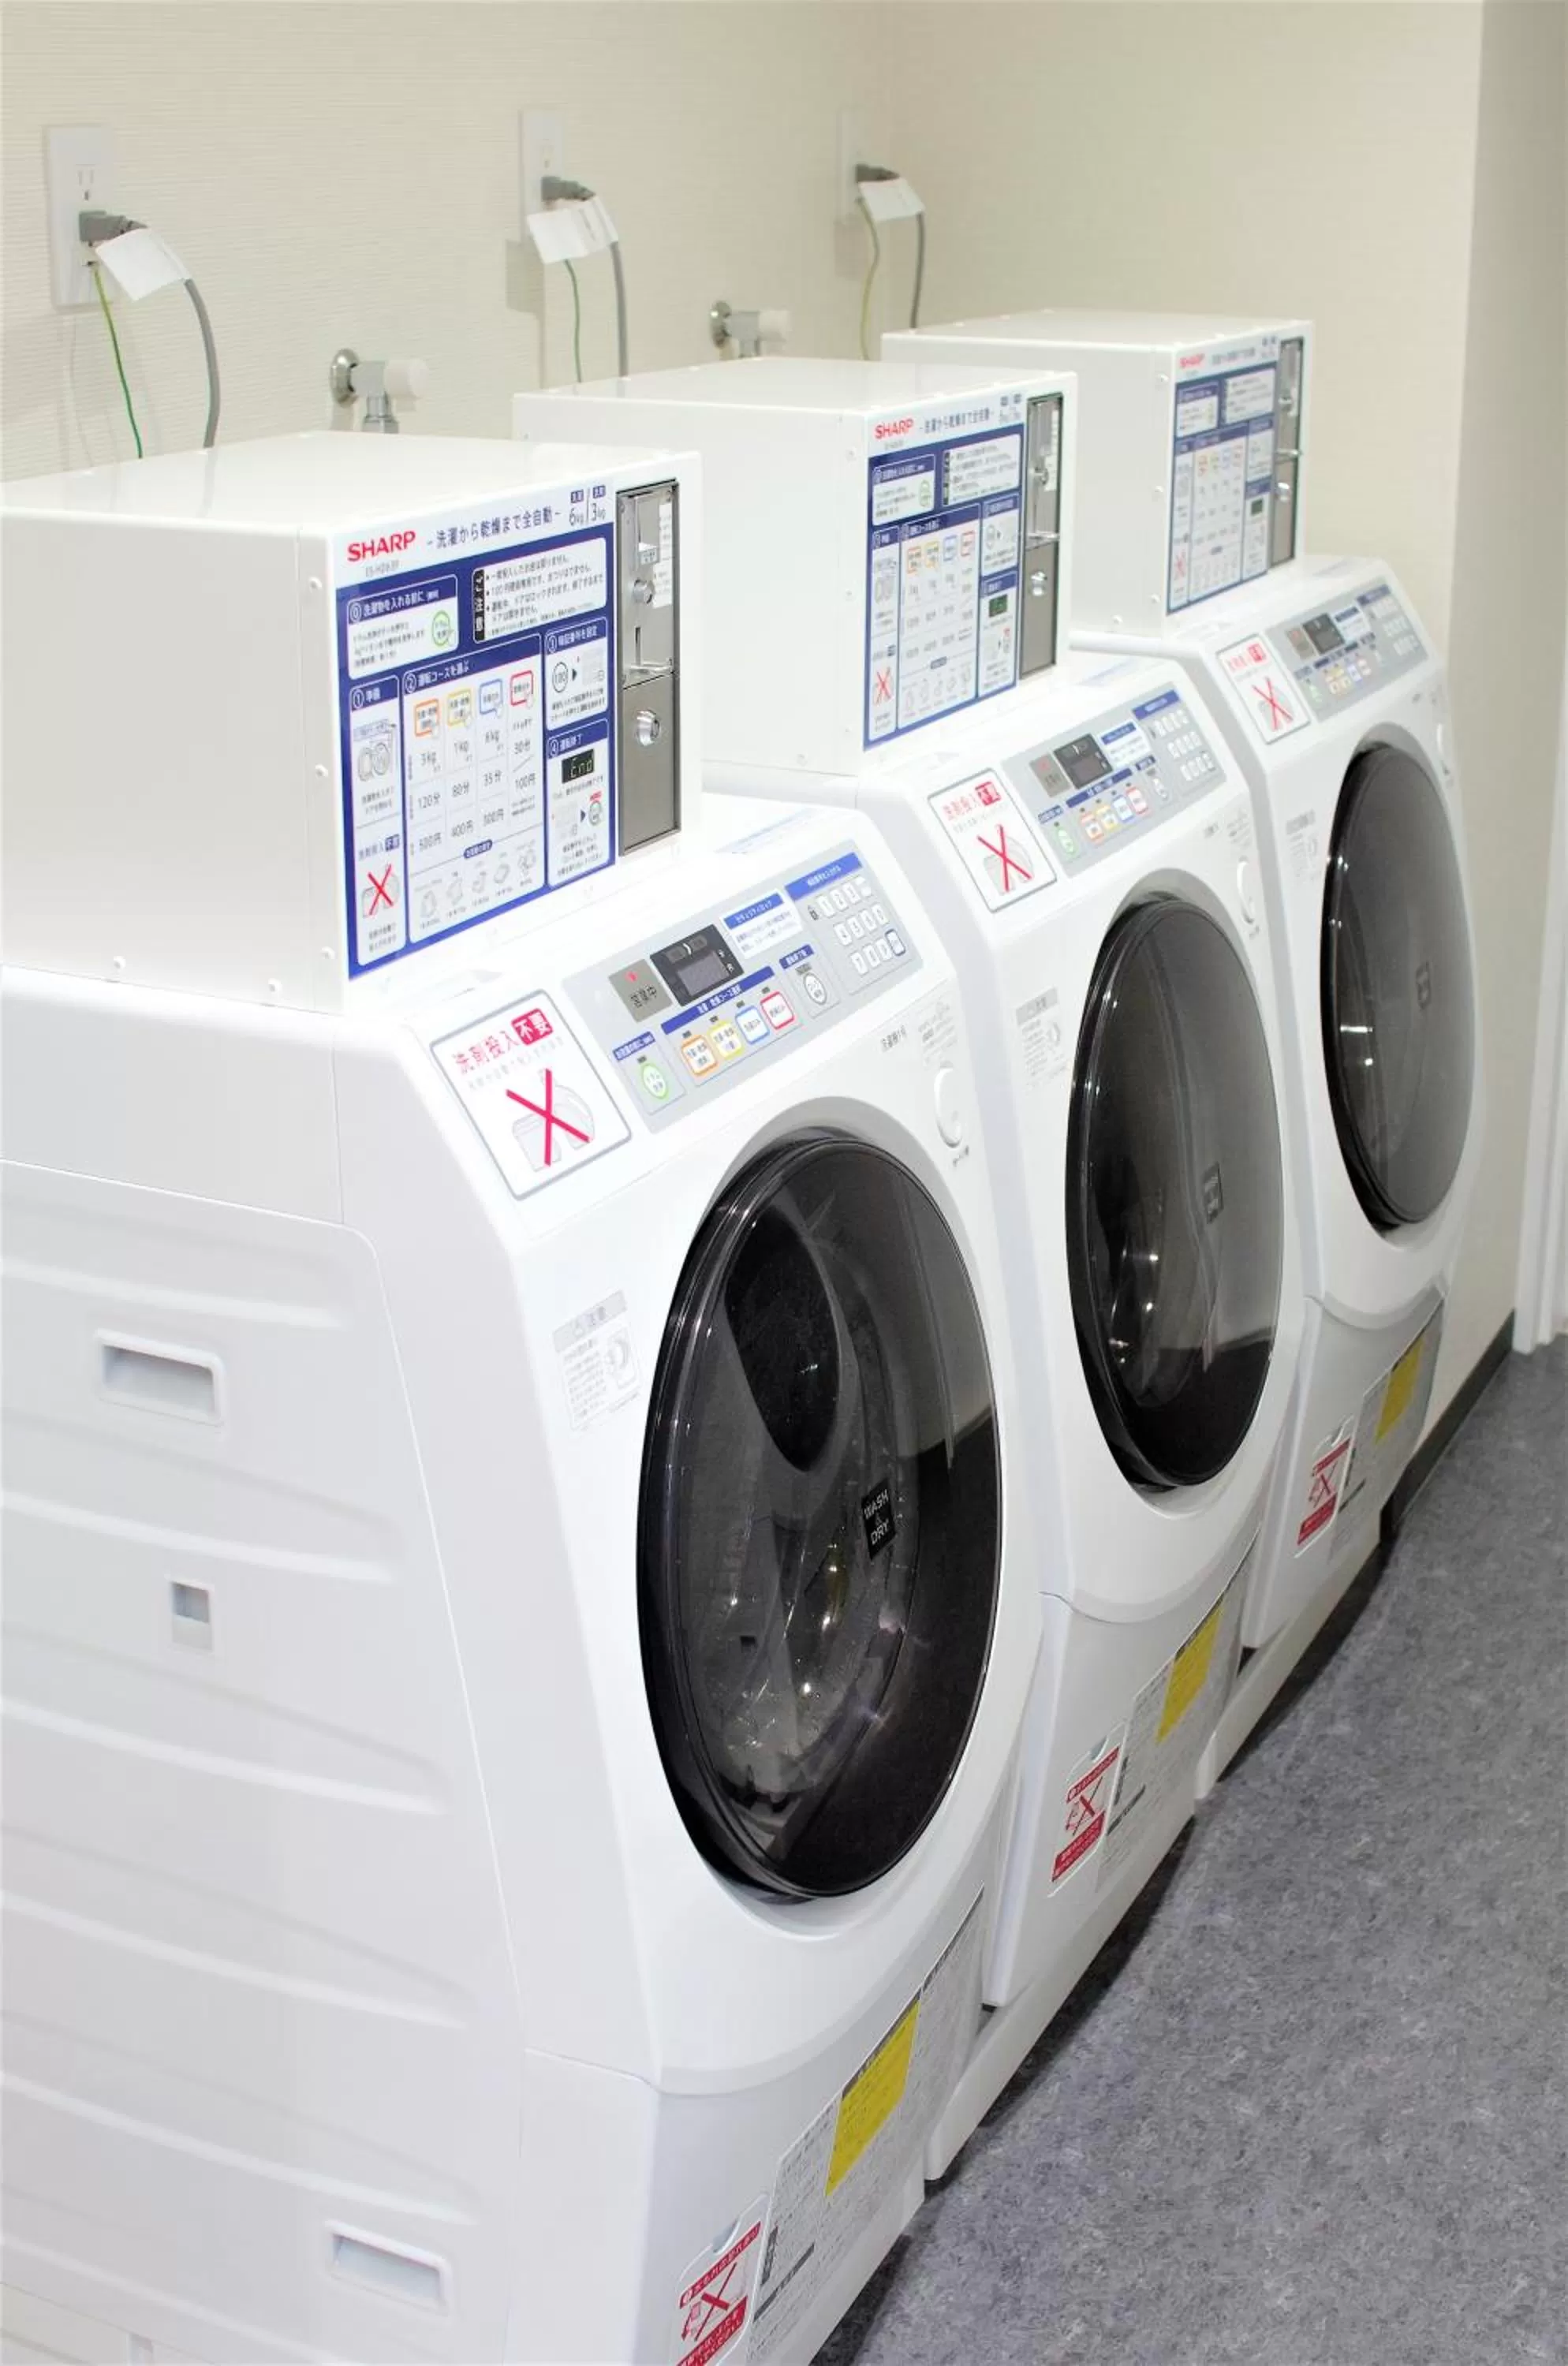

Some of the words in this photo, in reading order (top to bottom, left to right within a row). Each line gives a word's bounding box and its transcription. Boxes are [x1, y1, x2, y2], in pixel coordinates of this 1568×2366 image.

[875, 418, 914, 439] SHARP
[347, 530, 416, 562] SHARP
[864, 1488, 889, 1521] WASH
[871, 1517, 890, 1545] DRY
